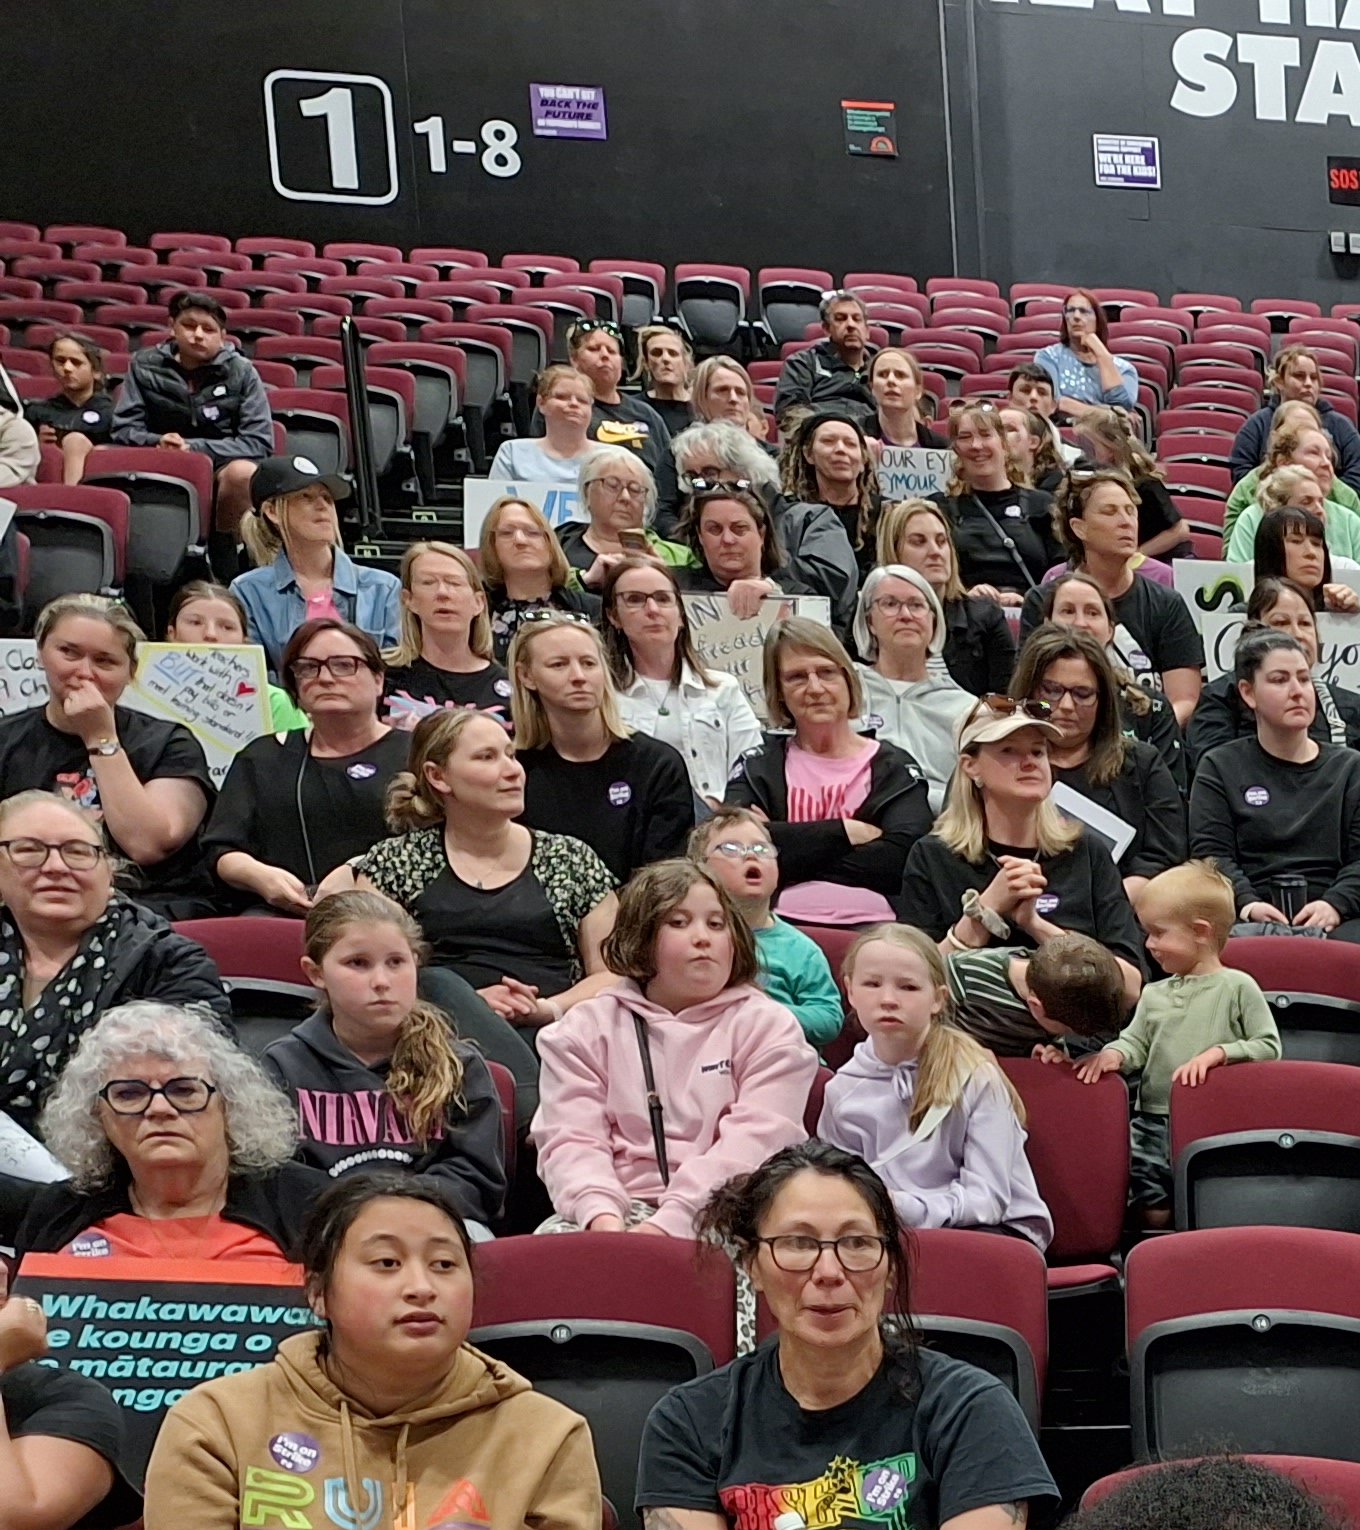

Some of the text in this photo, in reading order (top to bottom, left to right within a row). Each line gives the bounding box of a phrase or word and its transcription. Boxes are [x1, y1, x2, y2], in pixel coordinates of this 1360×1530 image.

[299, 86, 360, 190] 1
[413, 114, 523, 179] 1-8
[1330, 168, 1359, 189] SOS
[78, 1324, 273, 1355] kounga o
[273, 1446, 313, 1467] Strike
[277, 1436, 317, 1457] I'm on
